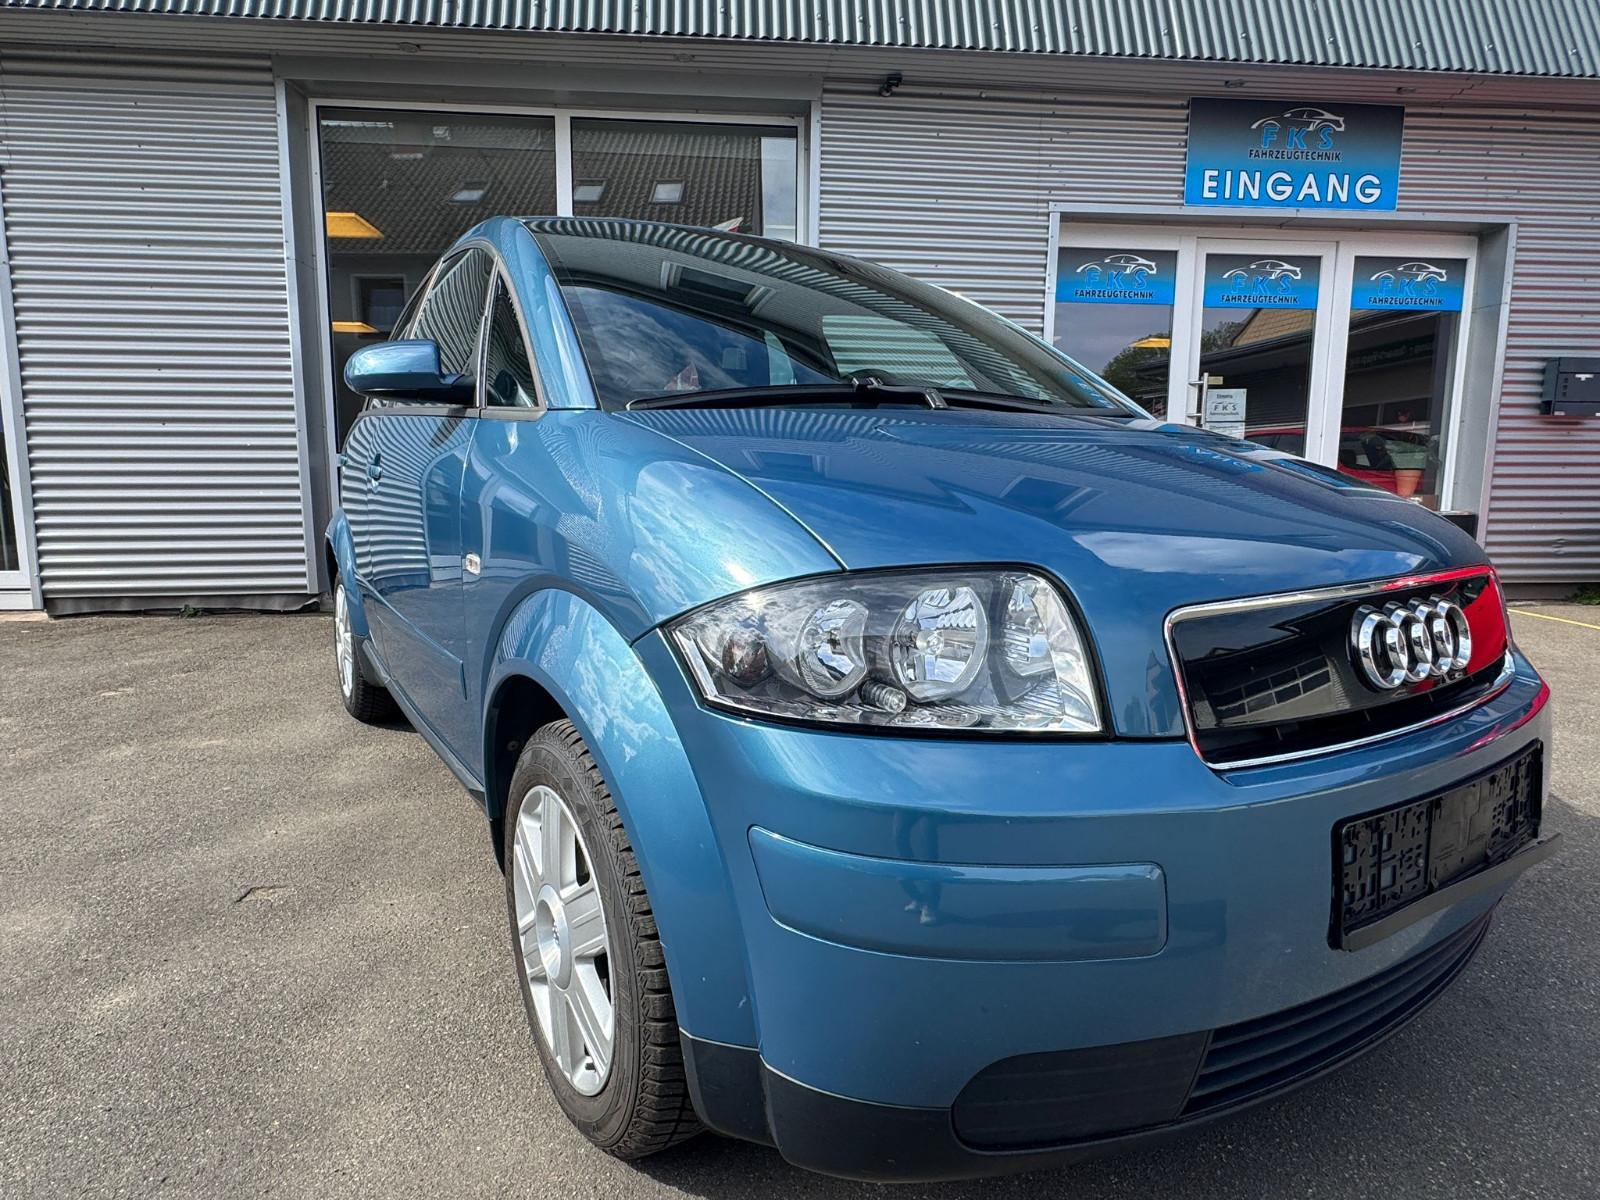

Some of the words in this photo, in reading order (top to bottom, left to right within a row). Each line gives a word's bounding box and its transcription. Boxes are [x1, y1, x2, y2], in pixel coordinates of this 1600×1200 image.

[1248, 149, 1342, 161] FAHRZEUGTECHNIK
[1202, 168, 1382, 204] EINGANG
[1074, 289, 1154, 299] FAHRZEUGTECHNIK
[1221, 294, 1299, 304] FAHRZEUGTECHNIK
[1368, 296, 1444, 306] FAHRZEUGTECHNIK
